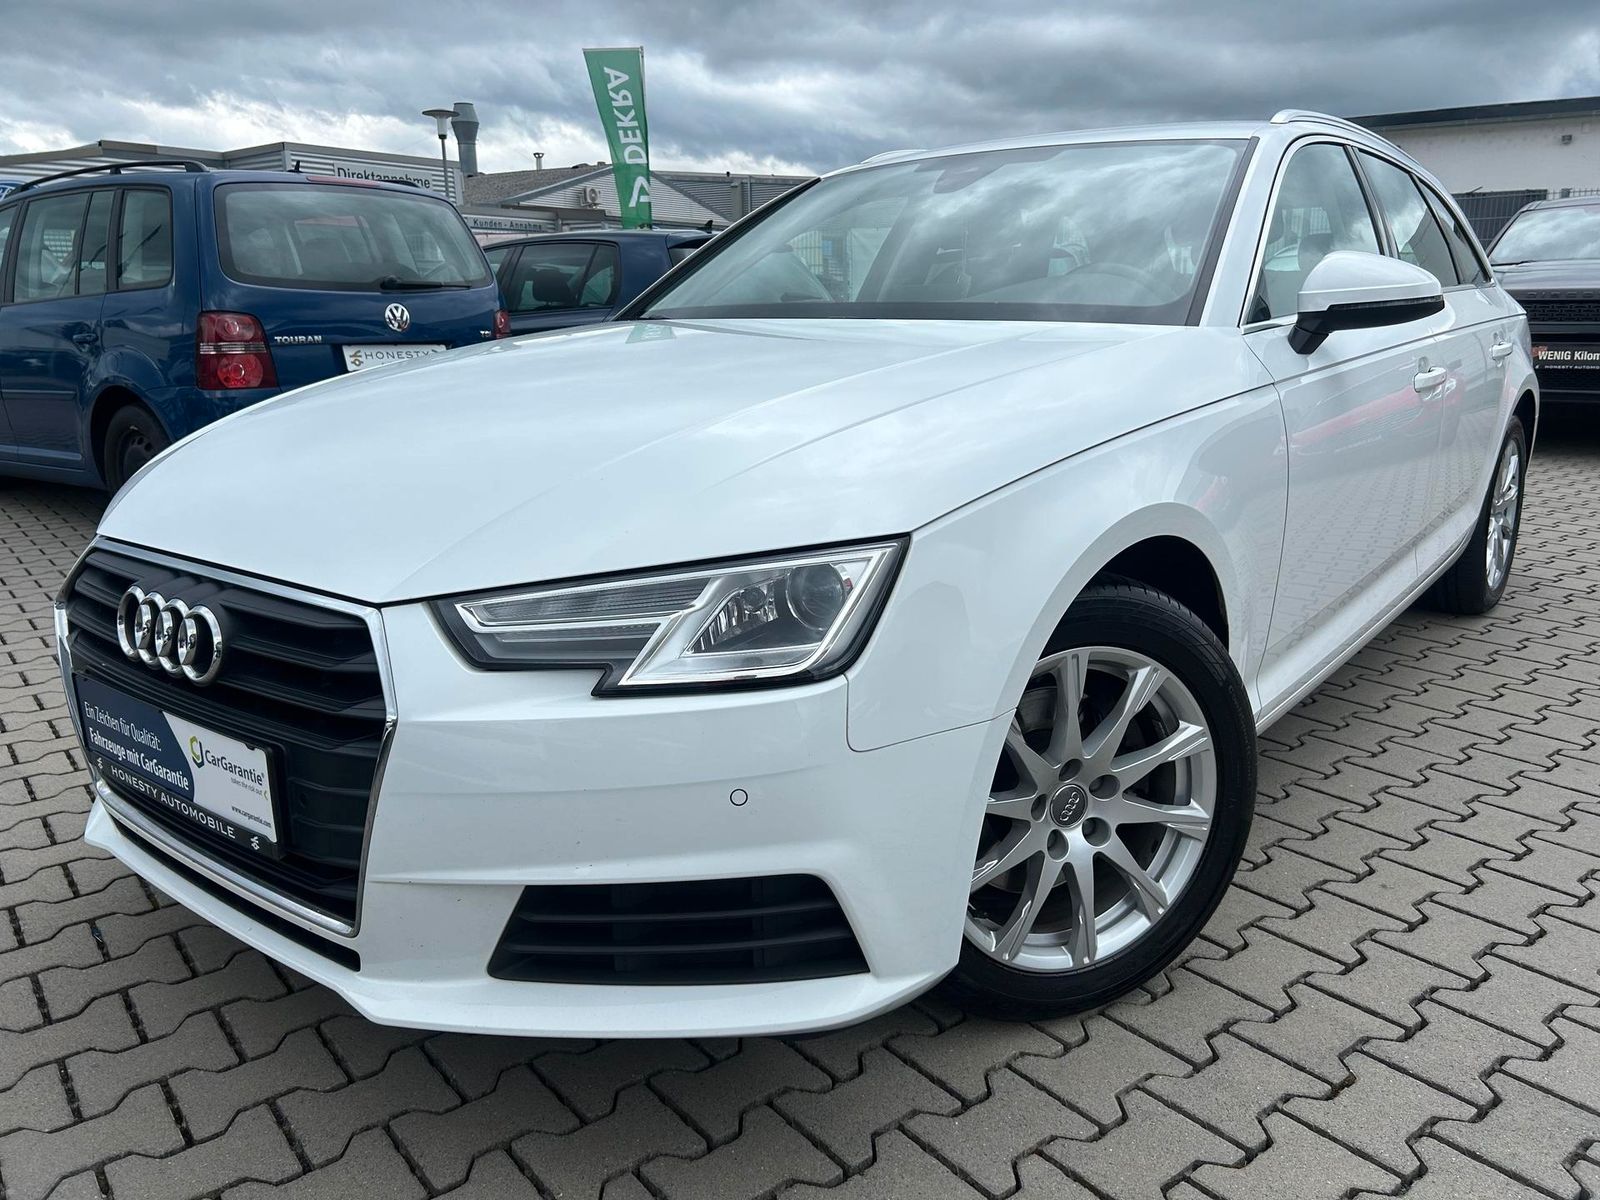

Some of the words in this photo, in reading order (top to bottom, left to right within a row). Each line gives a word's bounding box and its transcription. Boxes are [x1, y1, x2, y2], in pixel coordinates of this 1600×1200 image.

[337, 167, 430, 188] Direktannhme
[274, 335, 322, 344] TOURAN
[1538, 350, 1571, 360] WENIG
[84, 701, 96, 720] Ein
[95, 706, 121, 732] Zeichen
[120, 717, 131, 737] für
[130, 723, 162, 752] Qualität:
[88, 726, 126, 761] Fahrzeuge
[126, 748, 141, 767] mit
[140, 753, 190, 791] CarGarantie
[111, 765, 158, 799] HONESTY
[160, 792, 236, 839] AUTOMOBILE
